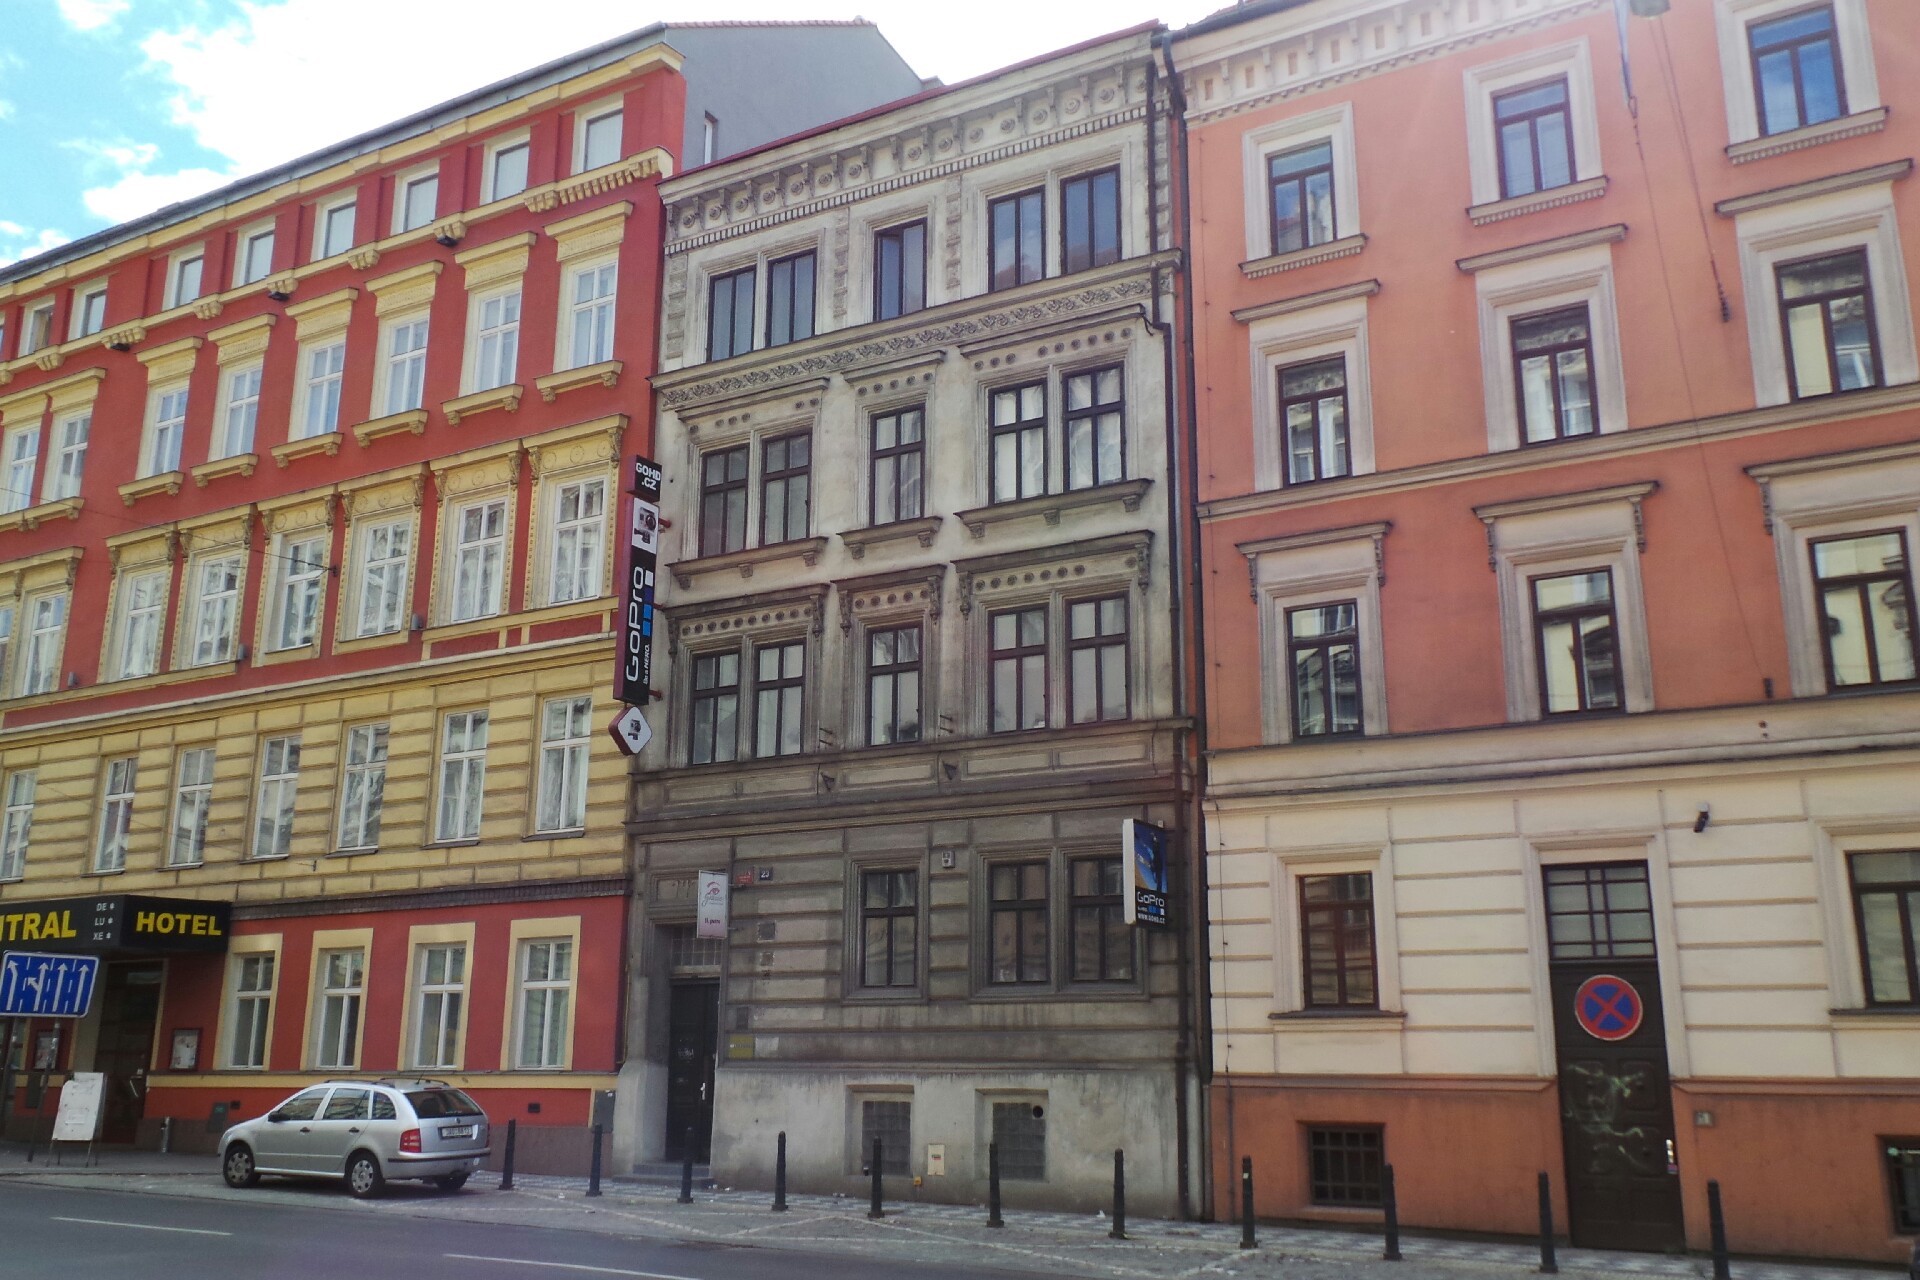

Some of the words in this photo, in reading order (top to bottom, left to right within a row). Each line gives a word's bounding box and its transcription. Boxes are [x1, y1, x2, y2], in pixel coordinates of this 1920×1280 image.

[635, 462, 661, 481] GOHD
[641, 477, 657, 490] .CZ
[626, 566, 644, 682] GoPro
[761, 870, 770, 878] 23
[1137, 891, 1165, 907] GoPro
[96, 902, 107, 911] DE
[0, 910, 77, 942] TRAL
[94, 917, 105, 926] LU
[135, 911, 222, 936] HOTEL
[93, 931, 104, 940] XE
